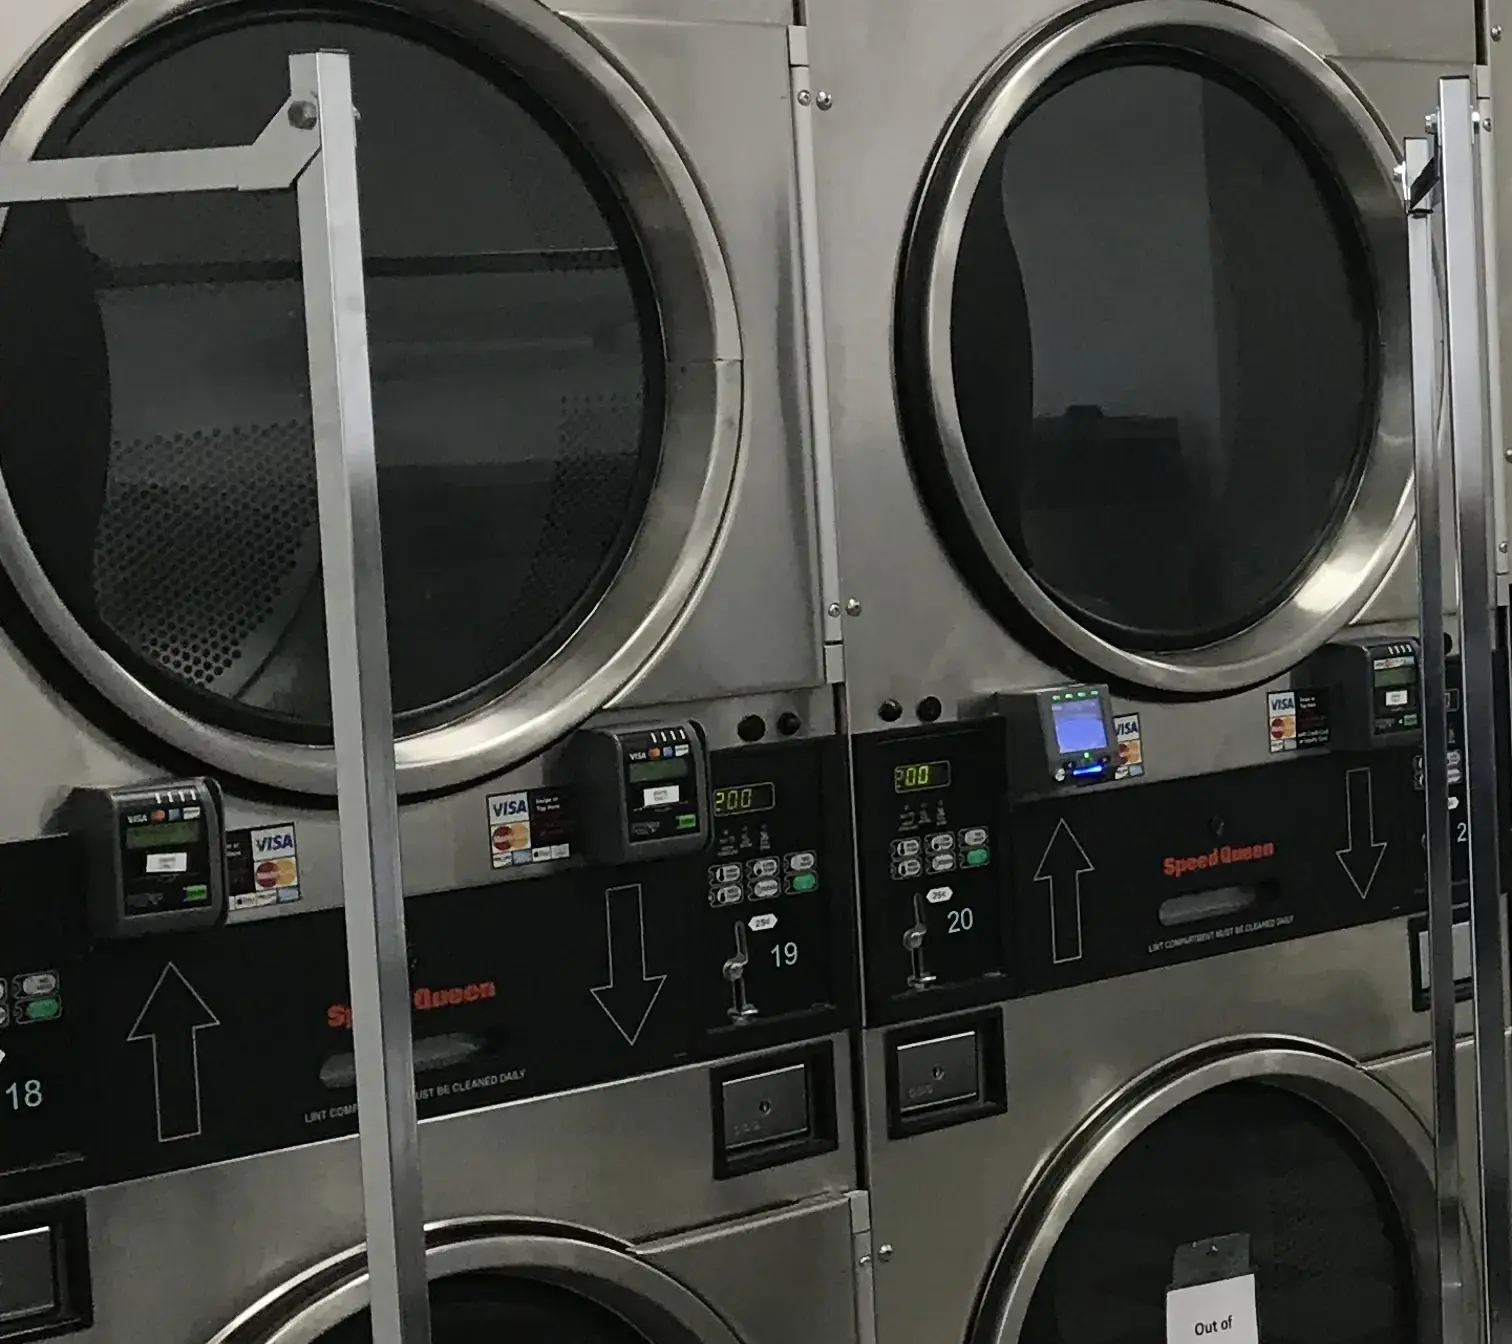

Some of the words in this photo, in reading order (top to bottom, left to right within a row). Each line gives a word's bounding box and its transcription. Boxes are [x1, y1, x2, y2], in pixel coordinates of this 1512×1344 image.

[1271, 698, 1295, 711] VISA
[492, 799, 528, 817] VISA
[255, 834, 294, 853] VISA
[1456, 821, 1469, 844] 2
[1162, 848, 1219, 878] Speed
[1220, 842, 1275, 864] Queen
[947, 907, 974, 934] 20
[770, 941, 799, 968] 19
[412, 980, 497, 1011] Queen
[5, 1079, 44, 1111] 18
[304, 1108, 328, 1125] LINT
[414, 1086, 435, 1102] UST
[436, 1083, 451, 1097] BE
[451, 1075, 498, 1093] CLEANED
[499, 1068, 527, 1084] DAILY
[1194, 1320, 1218, 1336] Out
[1220, 1314, 1233, 1330] of
